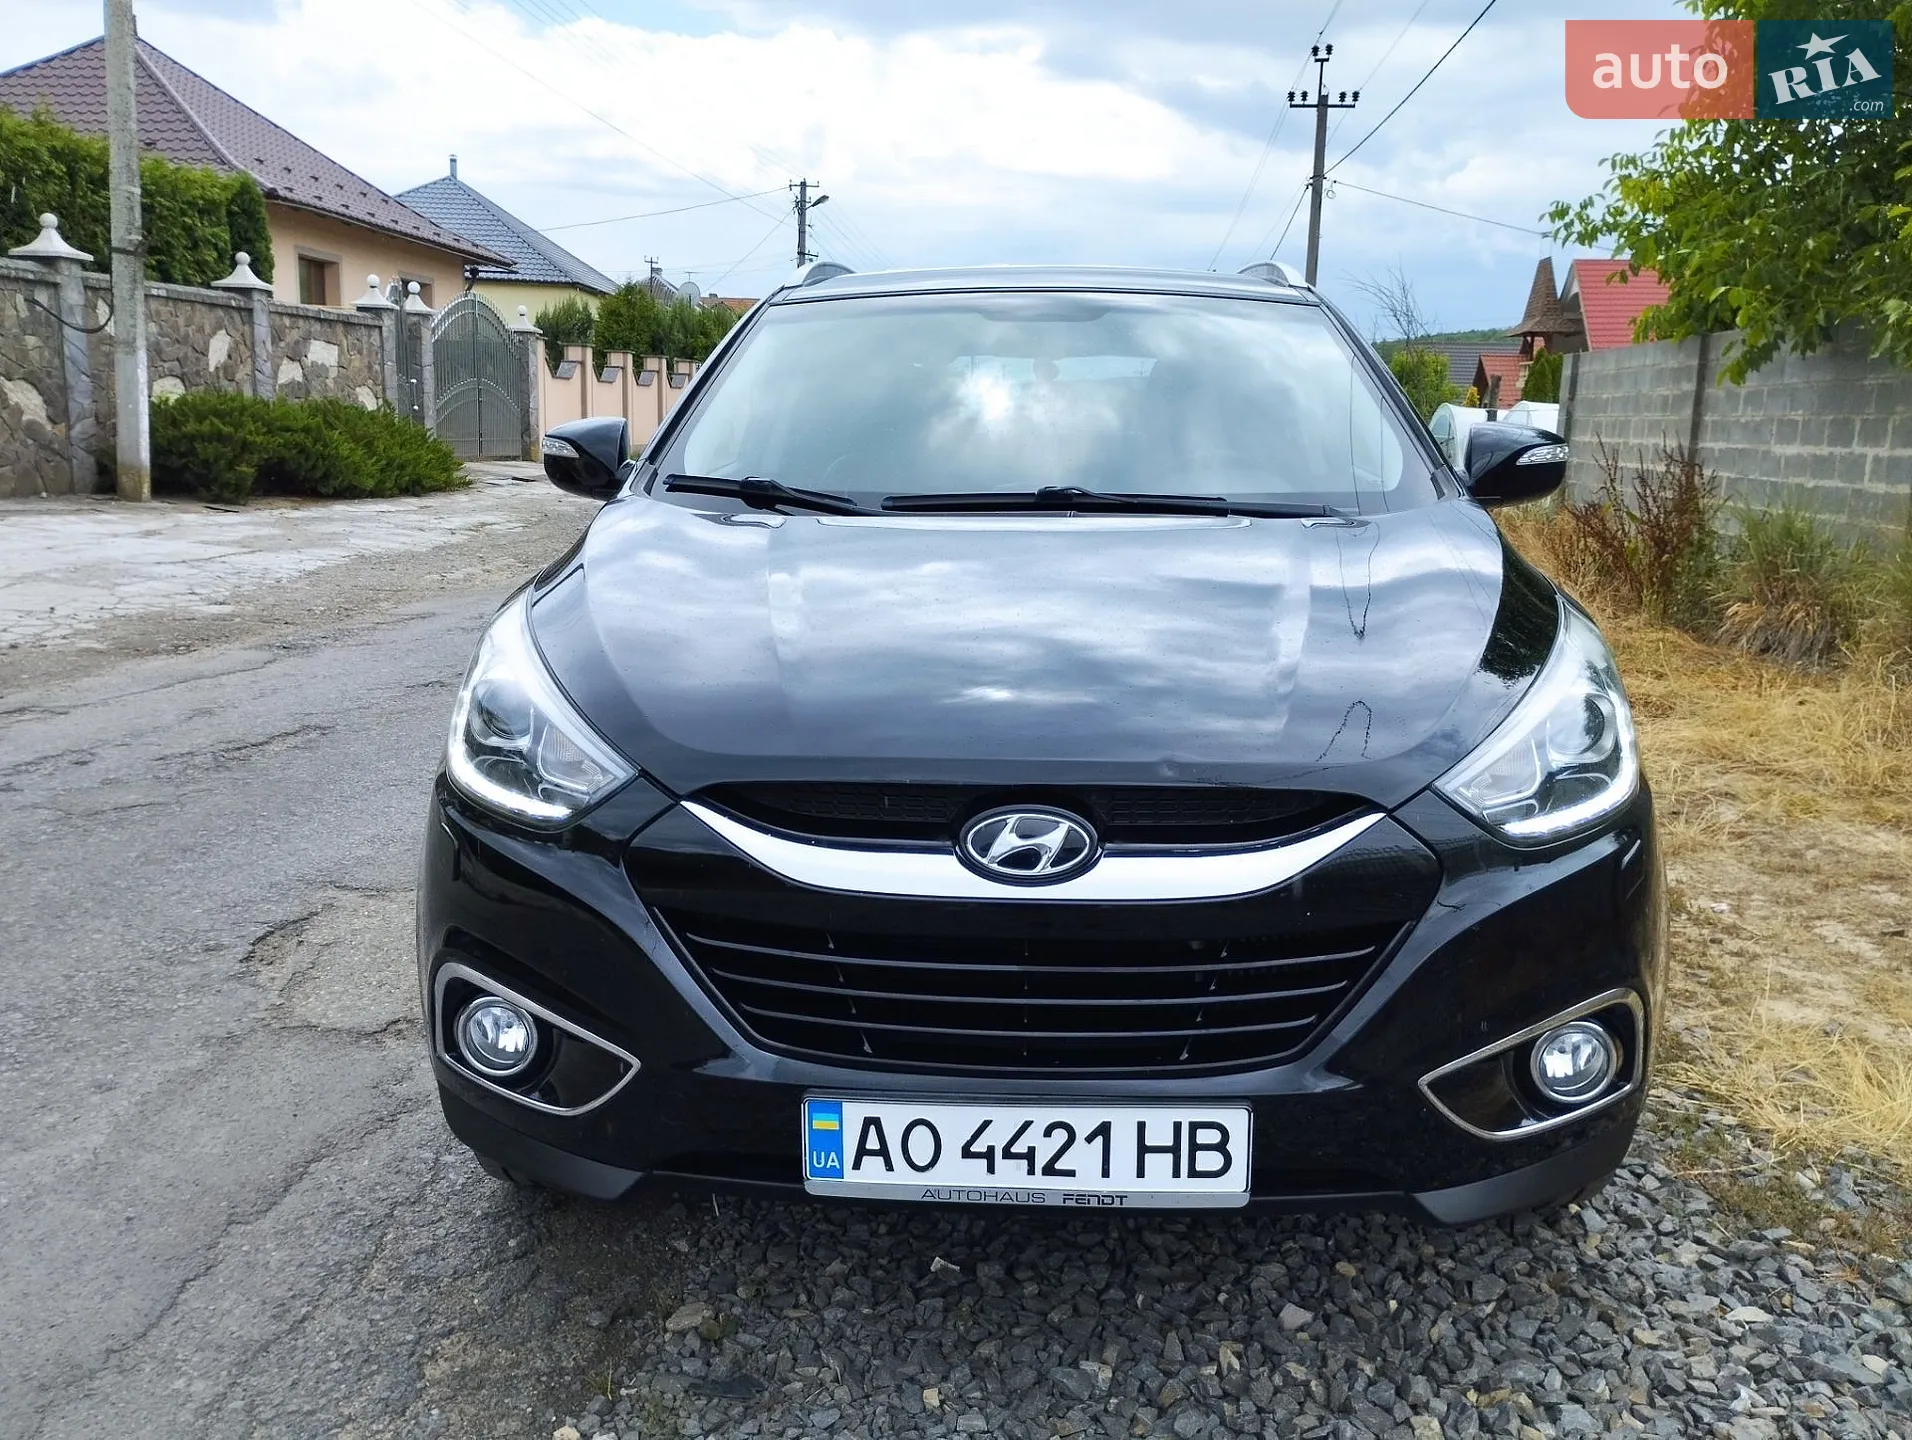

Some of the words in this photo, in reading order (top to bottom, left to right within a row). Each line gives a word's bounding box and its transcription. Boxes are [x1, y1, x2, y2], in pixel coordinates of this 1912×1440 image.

[851, 1116, 942, 1173] AO
[961, 1119, 1113, 1179] 4421
[1135, 1120, 1233, 1179] HB
[812, 1151, 840, 1169] UA
[920, 1188, 1046, 1204] AUTOHAUS
